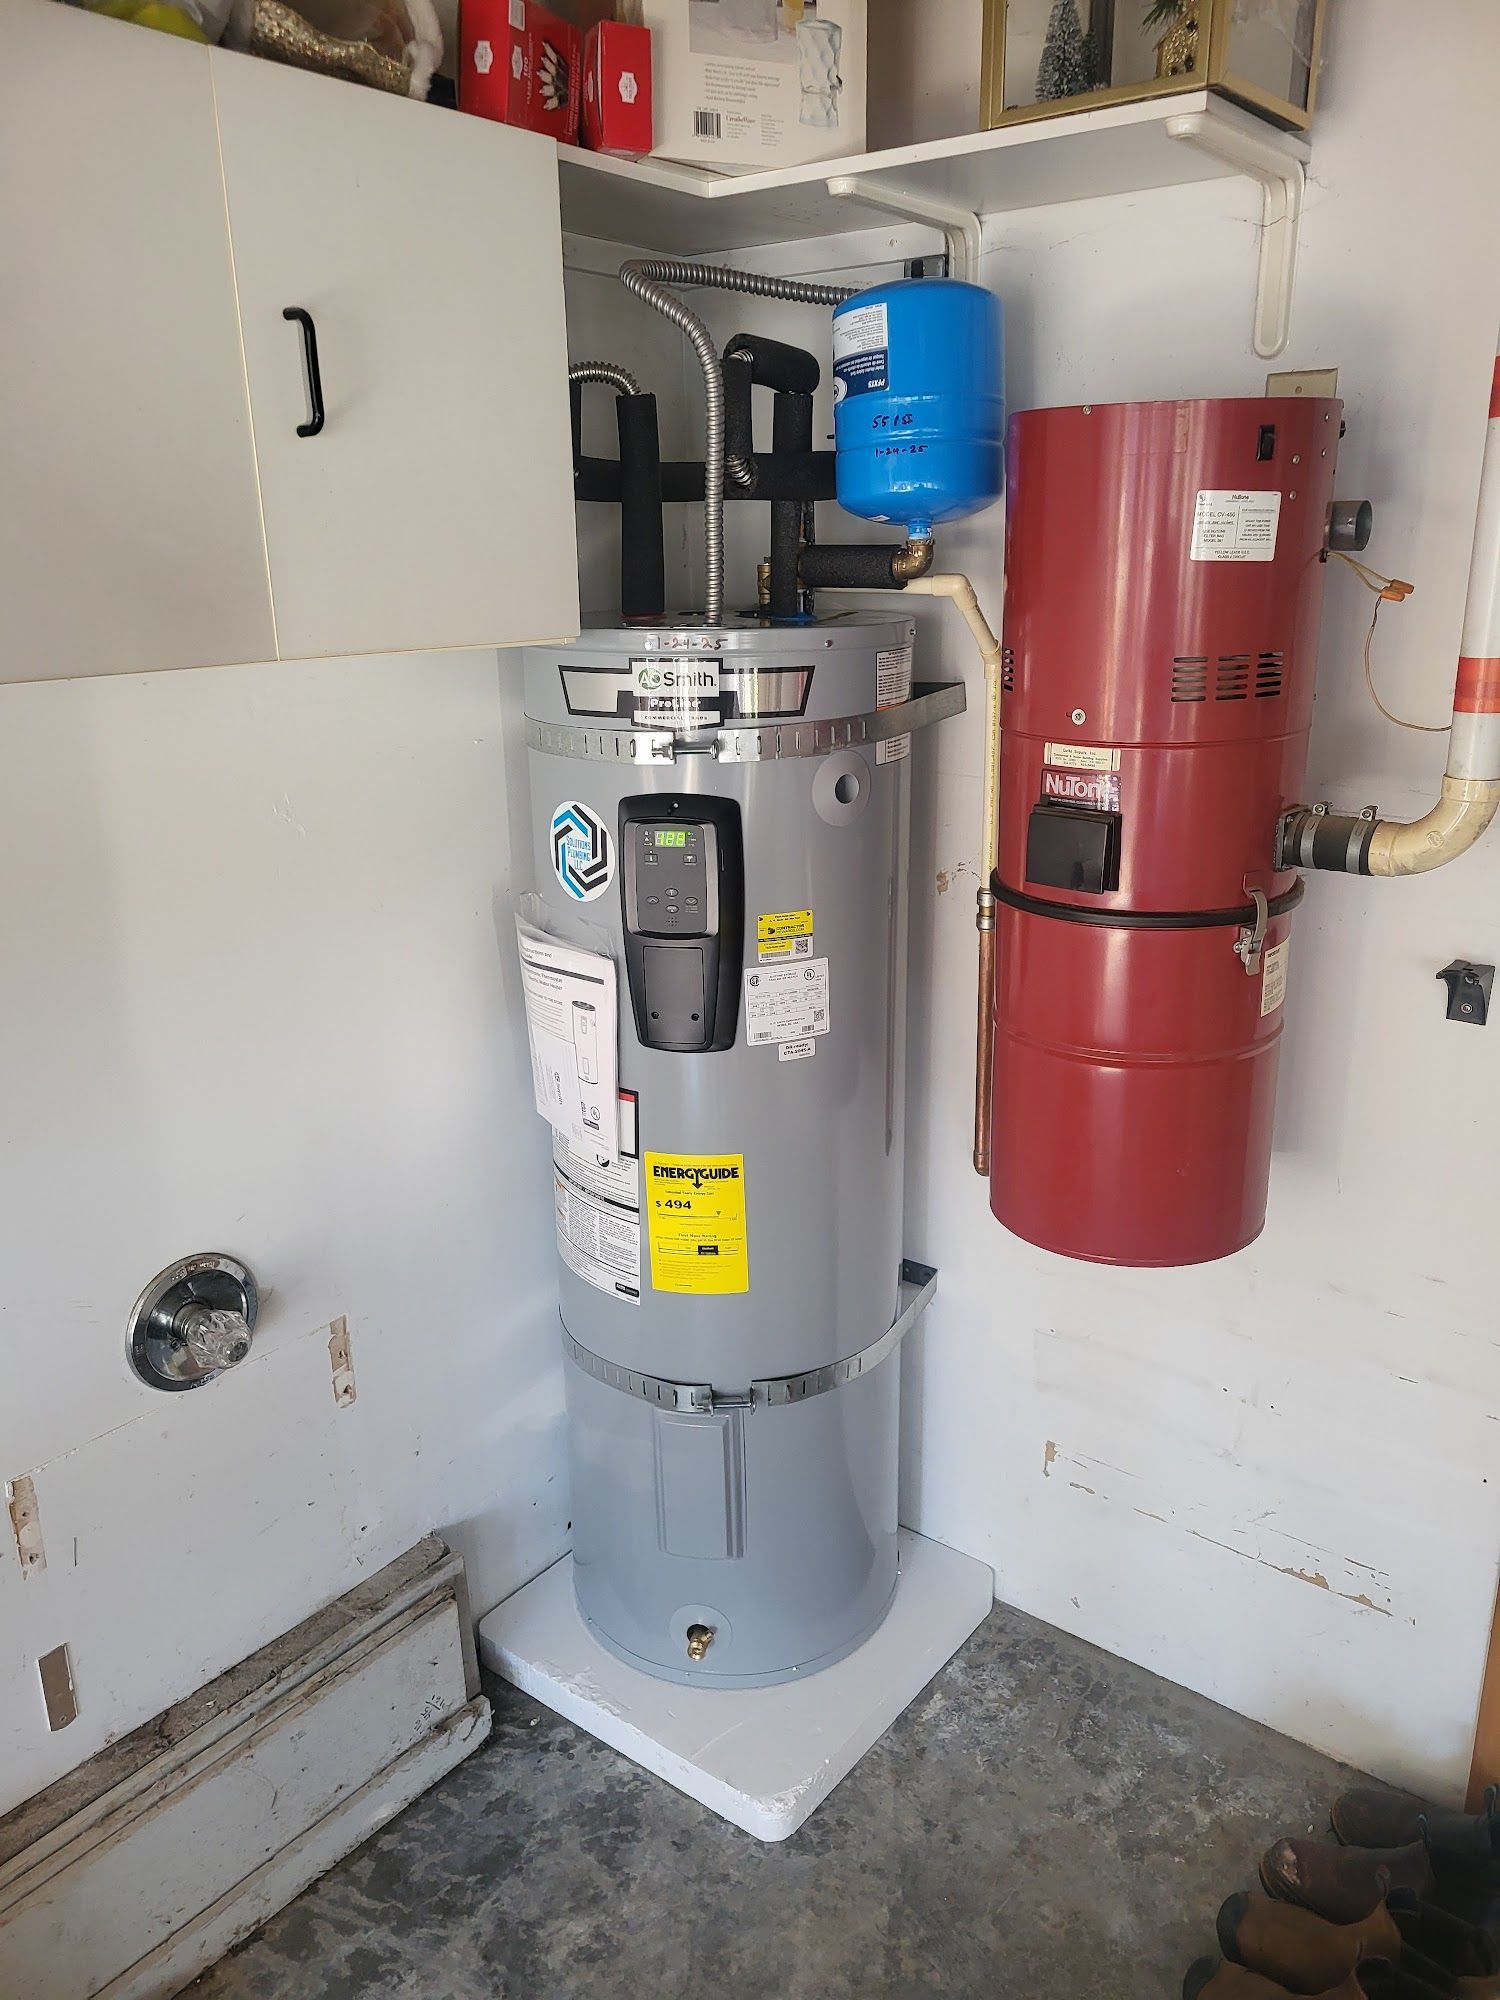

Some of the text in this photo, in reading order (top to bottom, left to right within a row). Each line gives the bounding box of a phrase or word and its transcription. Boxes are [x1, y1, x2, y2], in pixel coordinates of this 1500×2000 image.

[873, 414, 889, 428] 55
[875, 445, 928, 457] 1-24-25
[658, 636, 728, 650] 1-24-25
[653, 1166, 740, 1180] ENERGYGUIDE
[664, 1200, 692, 1210] 494
